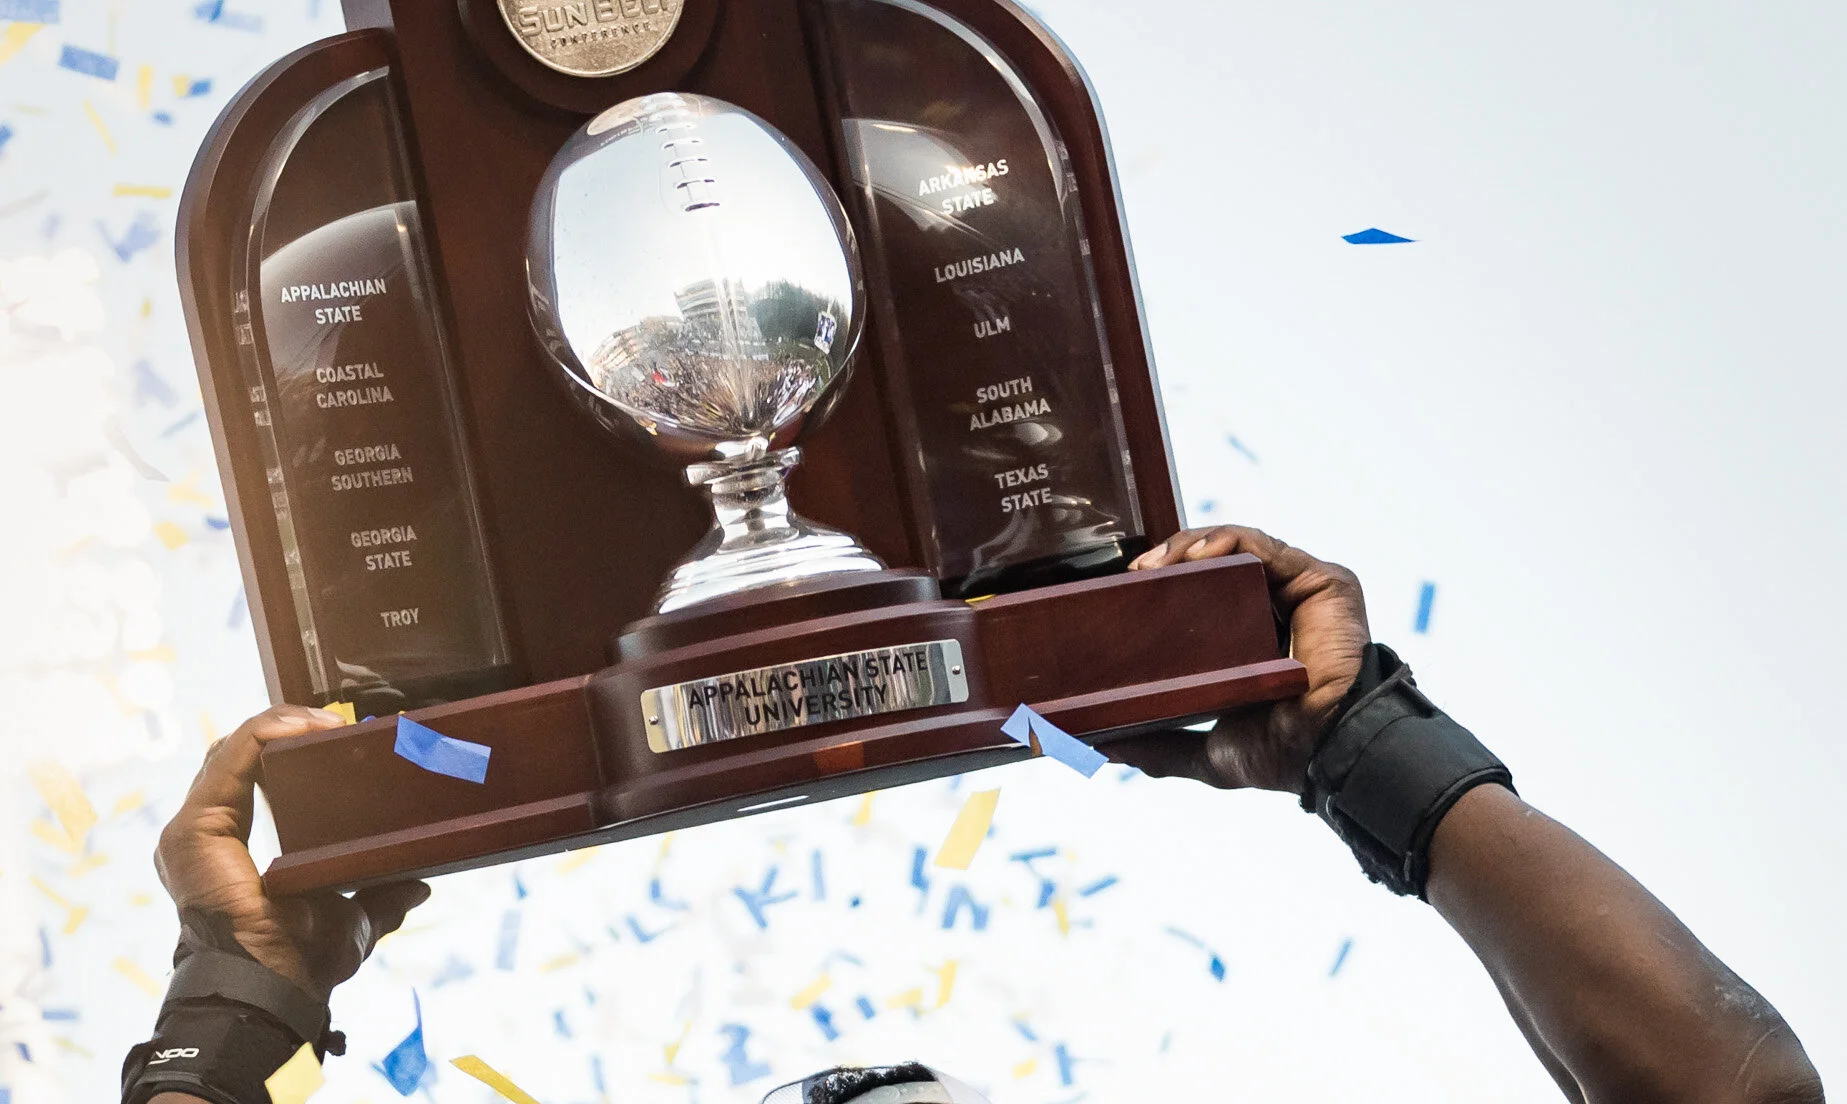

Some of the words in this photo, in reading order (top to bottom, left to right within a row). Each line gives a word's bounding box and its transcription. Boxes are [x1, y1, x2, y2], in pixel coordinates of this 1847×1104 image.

[518, 2, 589, 37] SUN
[918, 158, 1010, 197] ARKANSAS
[941, 188, 995, 215] STATE
[934, 247, 1025, 284] LOUISIANA
[280, 278, 387, 304] APPALACHIAN
[314, 305, 363, 325] STATE
[973, 316, 1011, 339] ULM
[315, 361, 384, 384] COASTAL
[315, 386, 394, 410] CAROLINA
[975, 376, 1033, 404] SOUTH
[969, 398, 1052, 432] ALABAMA
[334, 443, 402, 467] GEORGIA
[331, 467, 414, 493] SOUTHERN
[994, 463, 1050, 490] TEXAS
[1000, 487, 1053, 514] STATE
[350, 524, 418, 549] GEORGIA
[364, 550, 412, 571] STATE
[379, 606, 421, 630] TROY
[688, 661, 859, 709] APPALACHIAN
[866, 651, 928, 679] STATE
[745, 683, 889, 727] UNIVERSITY
